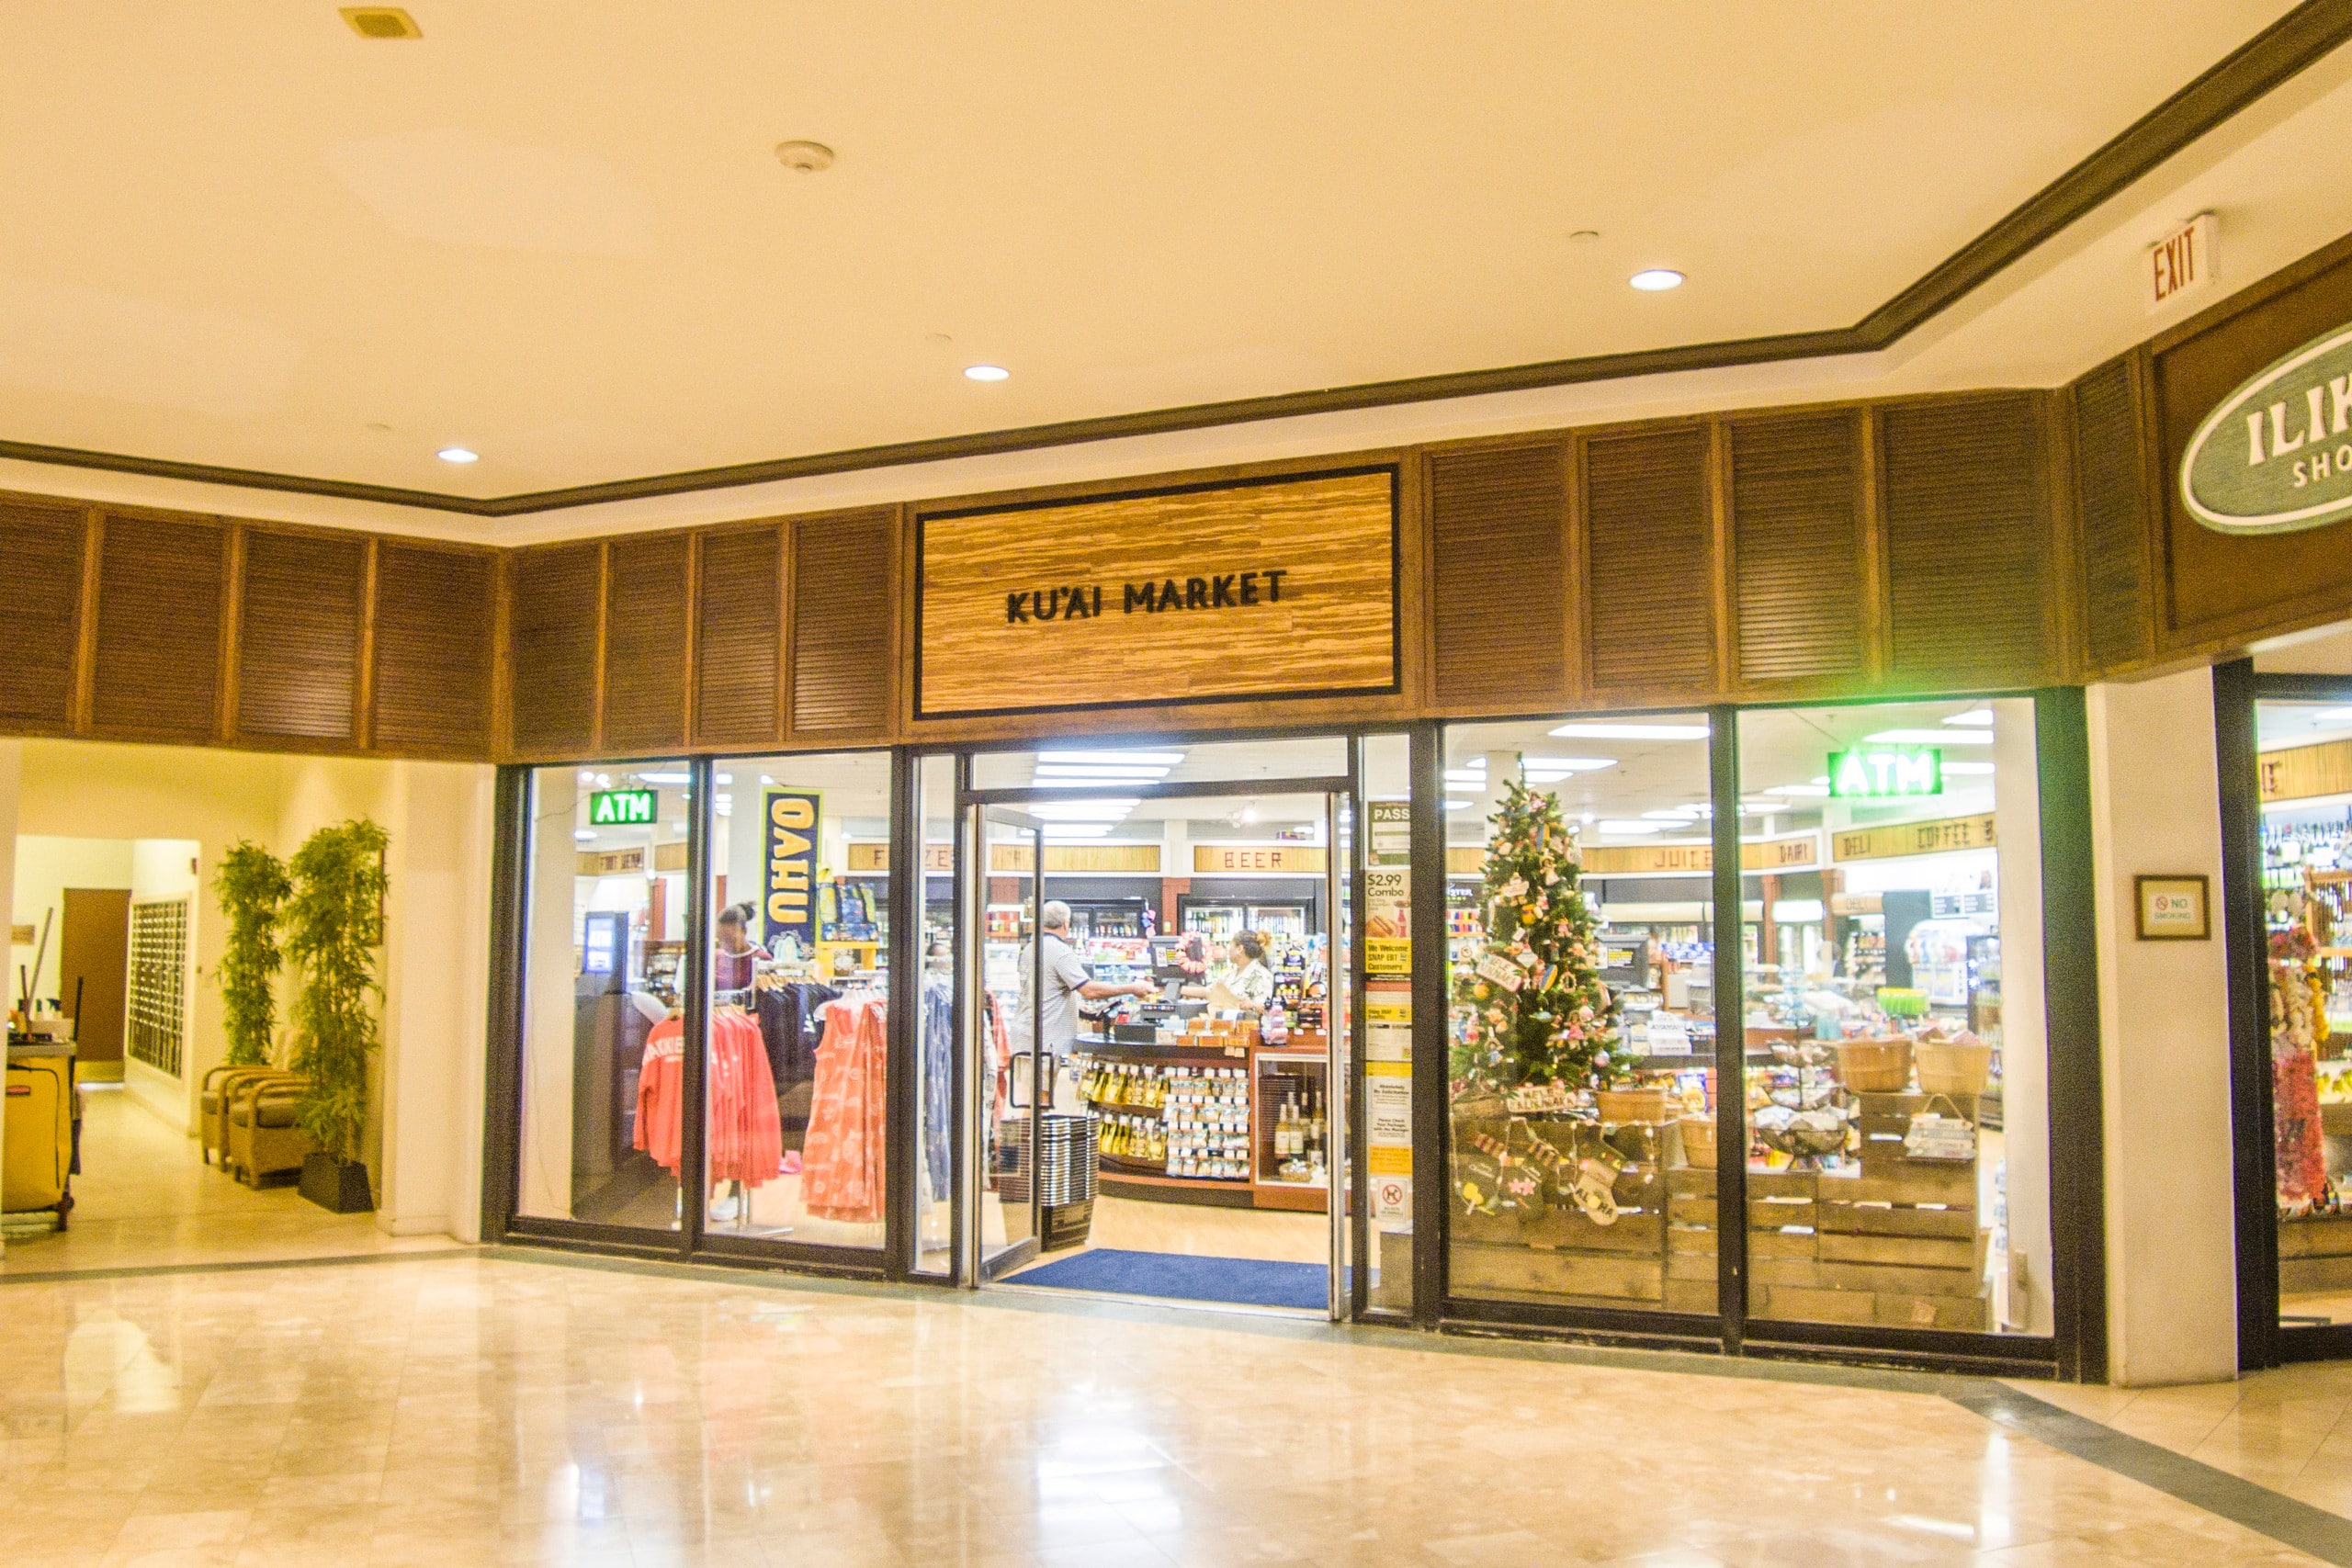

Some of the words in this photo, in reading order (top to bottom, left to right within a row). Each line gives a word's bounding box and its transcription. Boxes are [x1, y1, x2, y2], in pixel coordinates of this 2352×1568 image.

[2153, 226, 2195, 302] EXIT
[2293, 444, 2352, 488] SHO
[1123, 570, 1287, 615] MARKET
[1838, 751, 1933, 794] ATM
[595, 793, 650, 822] ATM
[768, 797, 815, 923] OAHU
[1224, 852, 1283, 869] BEER
[1367, 874, 1402, 886] $2.99
[1367, 887, 1405, 897] Combo
[2171, 898, 2188, 909] NO
